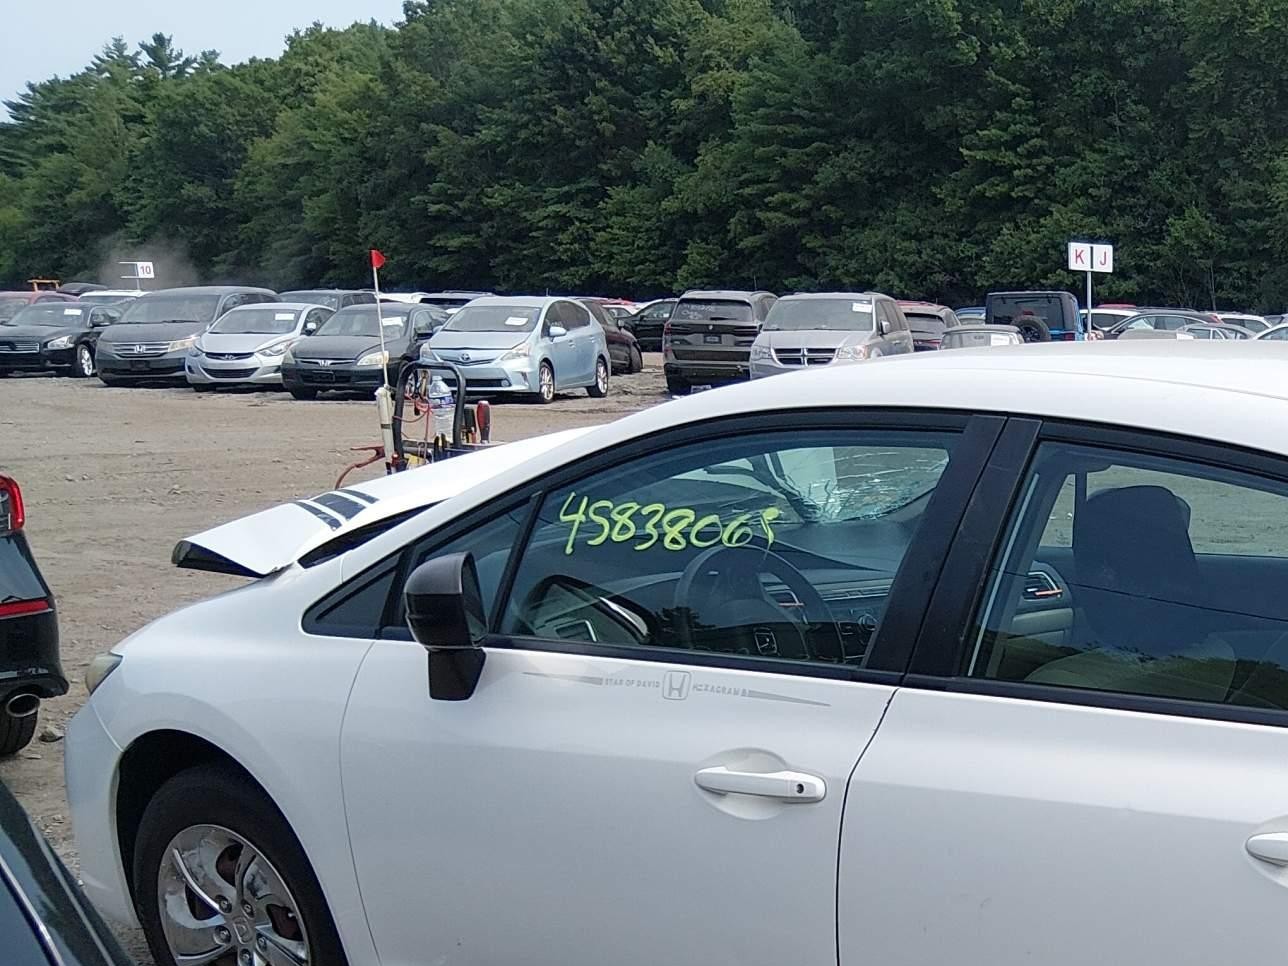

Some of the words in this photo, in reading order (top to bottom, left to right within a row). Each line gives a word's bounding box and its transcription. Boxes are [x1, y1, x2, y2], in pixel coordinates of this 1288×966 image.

[1075, 249, 1085, 265] K
[1100, 251, 1107, 265] J
[140, 265, 151, 275] 10
